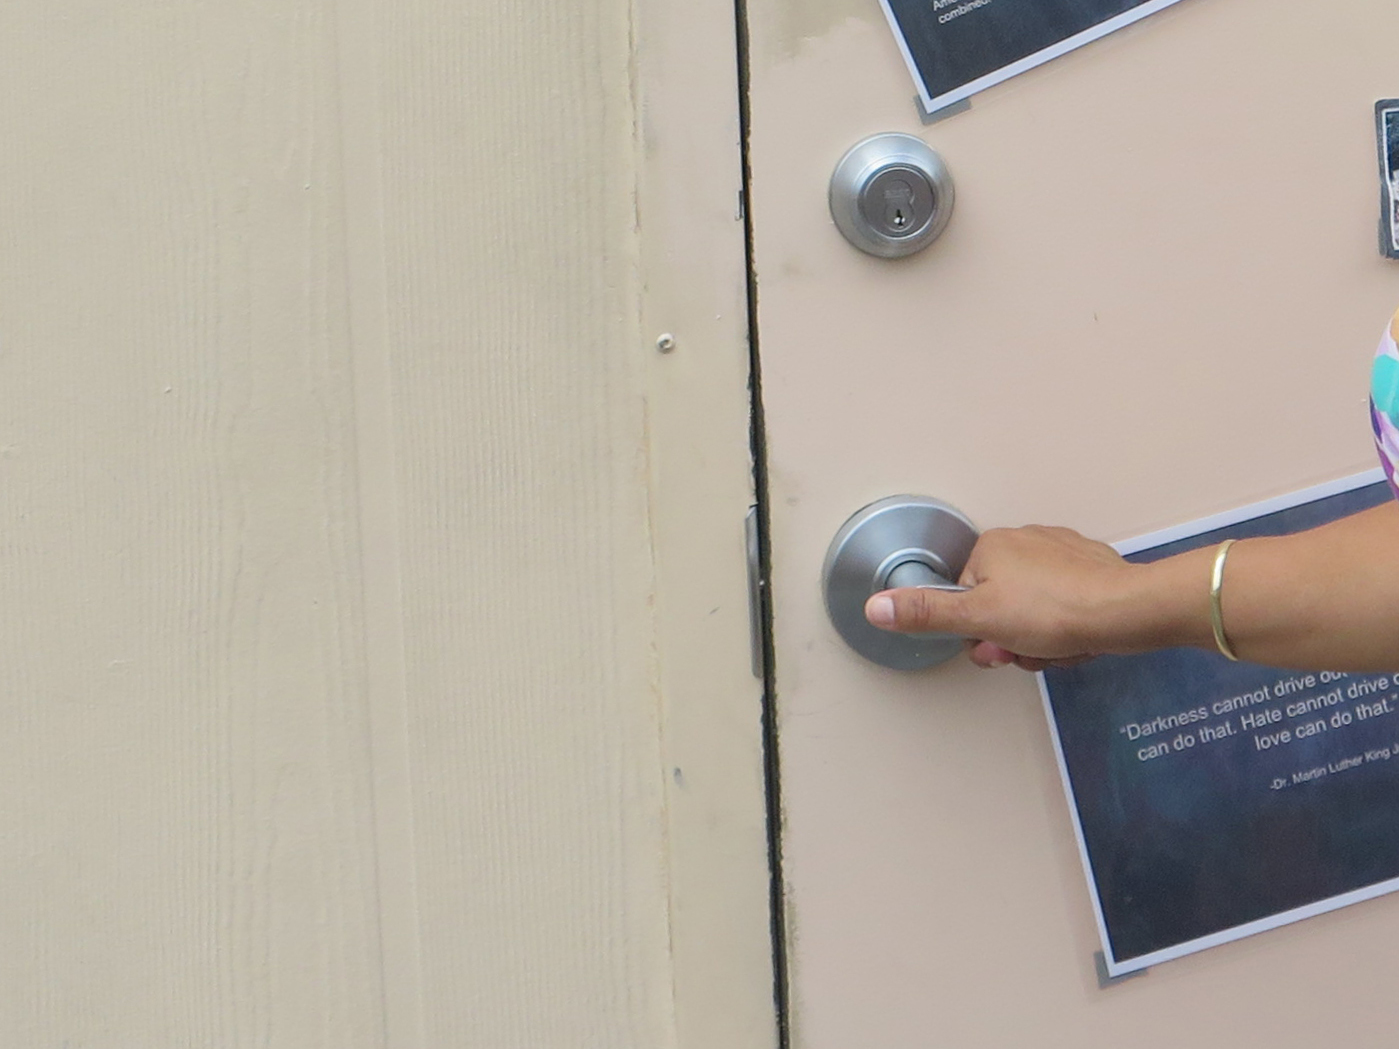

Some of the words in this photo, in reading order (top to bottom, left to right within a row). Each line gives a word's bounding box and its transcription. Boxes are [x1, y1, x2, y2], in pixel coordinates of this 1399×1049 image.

[1212, 686, 1271, 715] cannot
[1274, 674, 1316, 698] drive
[1137, 742, 1170, 762] can
[1173, 731, 1196, 751] do
[1198, 721, 1237, 743] that.
[1240, 709, 1283, 732] Hate
[1286, 691, 1345, 719] cannot
[1347, 678, 1389, 702] drive
[1254, 731, 1292, 751] love
[1296, 721, 1327, 739] can
[1331, 708, 1352, 728] do
[1292, 766, 1327, 785] Martin
[1327, 755, 1363, 775] Luther
[1364, 748, 1390, 765] King
